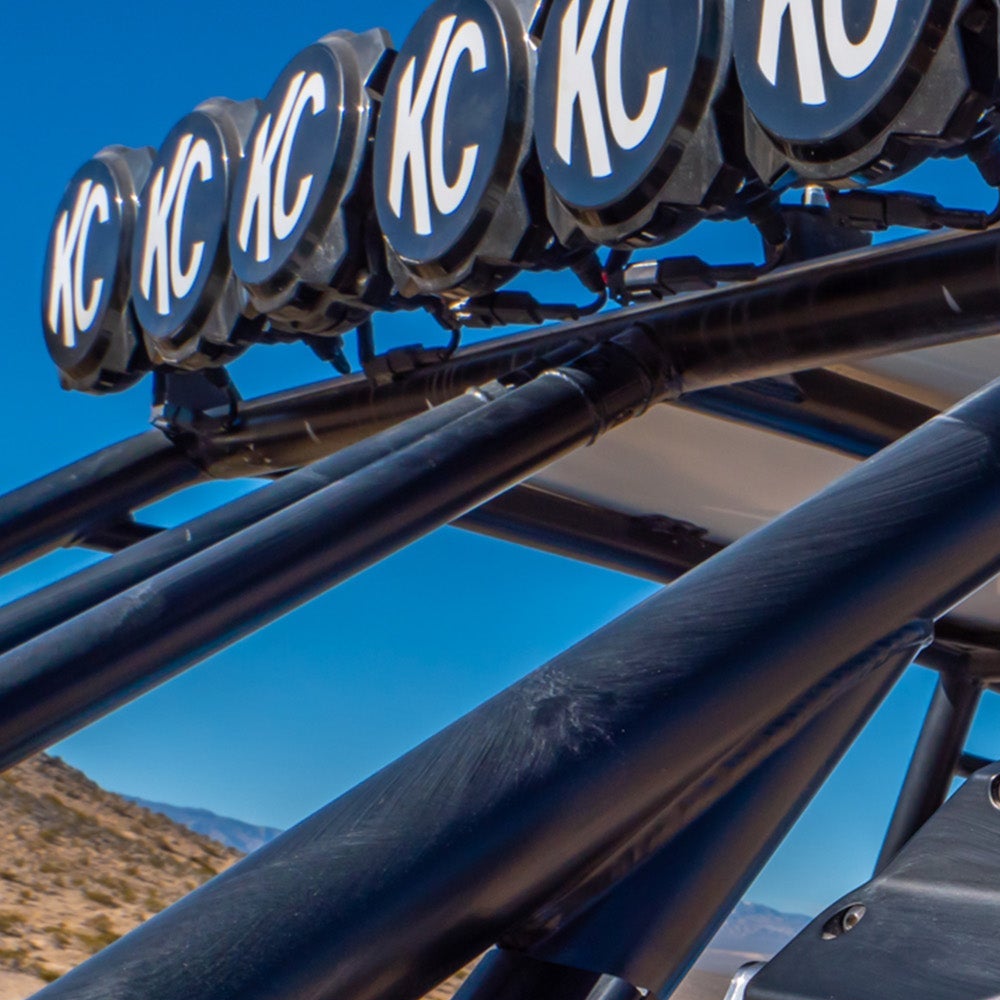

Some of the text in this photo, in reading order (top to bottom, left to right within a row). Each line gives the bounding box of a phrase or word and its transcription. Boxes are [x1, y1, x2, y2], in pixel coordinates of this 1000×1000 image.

[238, 71, 326, 263] KC
[388, 15, 487, 236] KC
[554, 0, 668, 178] KC
[48, 178, 110, 348] KC
[140, 133, 213, 315] KC
